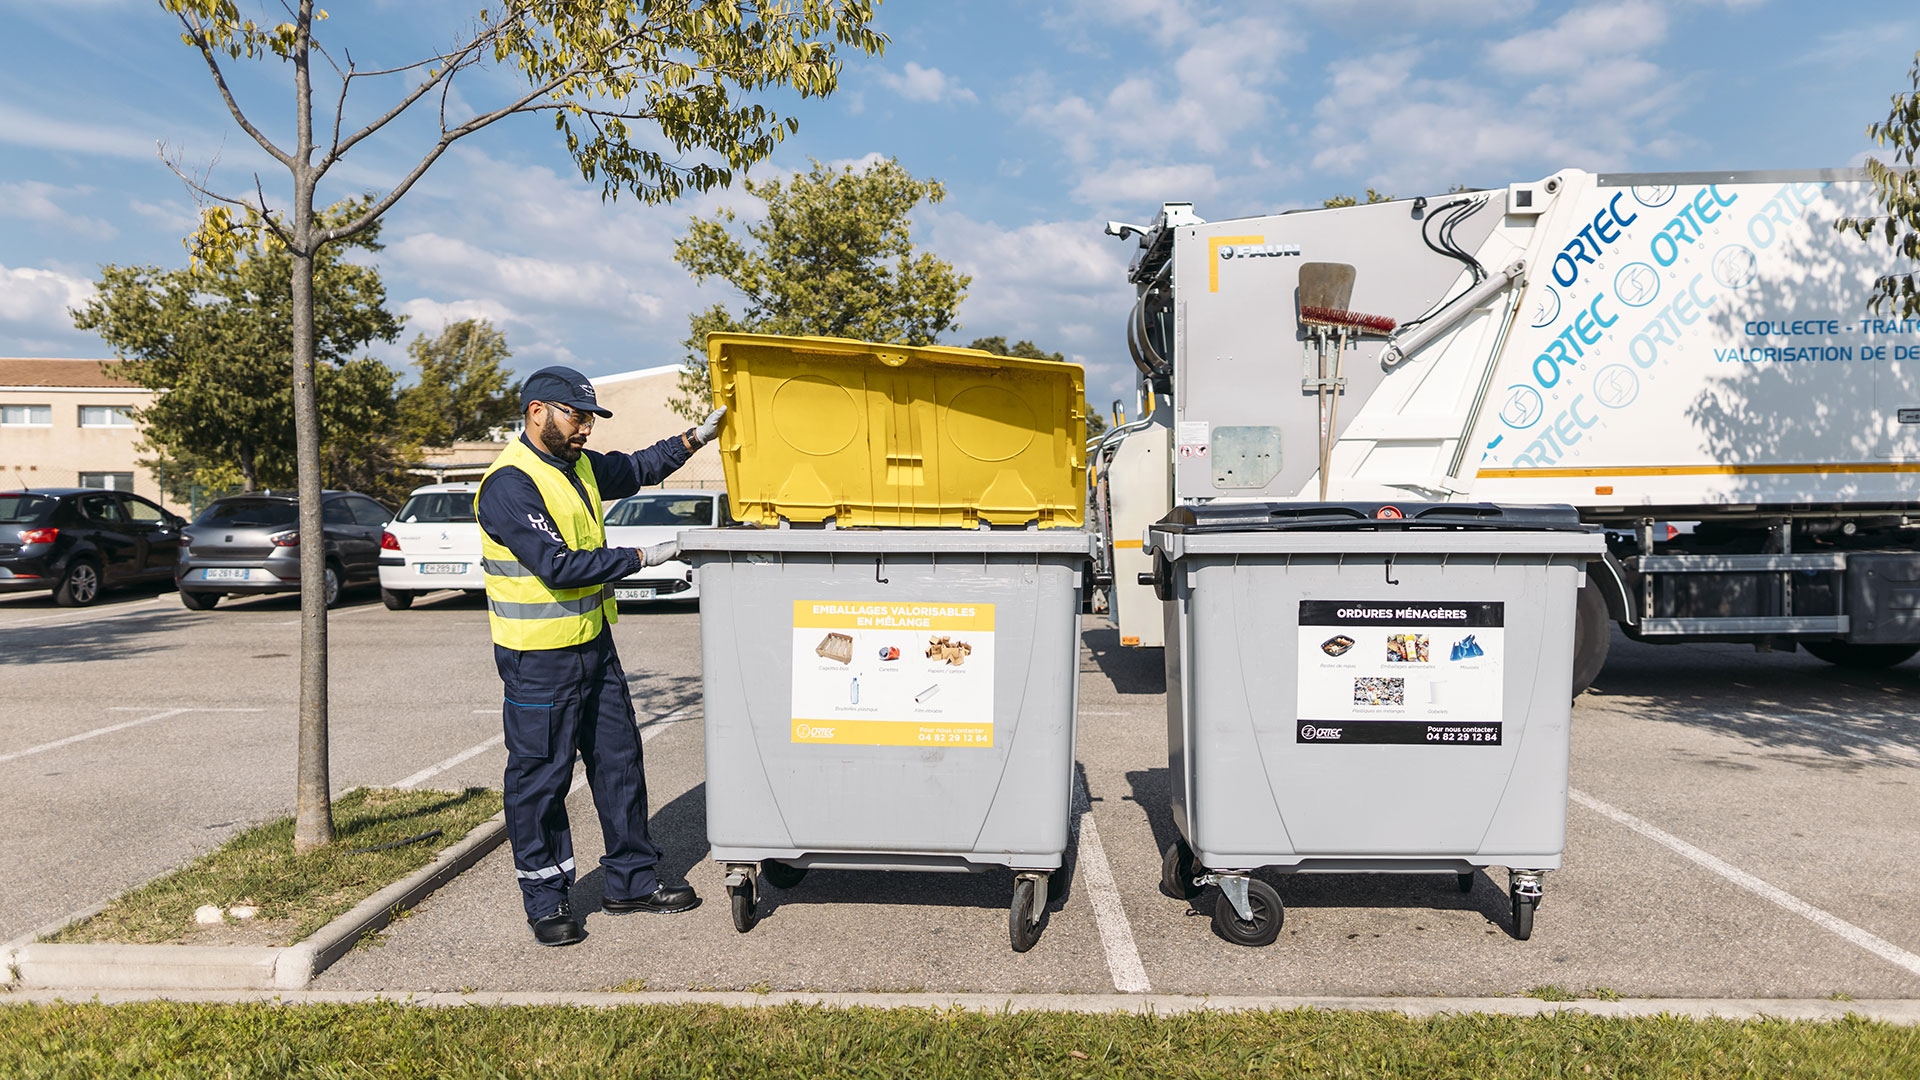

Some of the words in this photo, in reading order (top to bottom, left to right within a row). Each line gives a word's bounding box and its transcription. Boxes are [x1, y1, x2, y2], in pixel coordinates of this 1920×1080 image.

[1747, 182, 1832, 249] ORTE
[1651, 184, 1739, 267] ORTEC
[1552, 191, 1638, 288] ORTEC
[1237, 243, 1301, 259] FAUN
[1629, 272, 1718, 369] ORTEC
[1744, 320, 1839, 336] COLLECTE
[1532, 292, 1620, 389] ORTEC
[1713, 346, 1852, 363] VALORISATION
[1861, 346, 1886, 361] DE
[812, 605, 888, 616] EMBALLAGES
[890, 606, 976, 617] VALORISABLES
[1336, 608, 1394, 619] ORDURES
[1395, 607, 1468, 620] MÉNAGÈRES
[857, 616, 873, 626] EN
[875, 615, 931, 627] MÉLANGE
[810, 727, 836, 737] ORTEC
[1316, 727, 1342, 737] ORTEC
[1427, 725, 1444, 733] Pour
[918, 733, 931, 742] 04
[934, 733, 946, 742] 82
[948, 734, 961, 742] 29
[963, 734, 973, 742] 12
[975, 734, 988, 742] 84
[1426, 732, 1440, 741] 04
[1442, 733, 1455, 741] 82
[1457, 733, 1470, 741] 29
[1472, 733, 1483, 741] 12
[1484, 733, 1498, 741] 84
